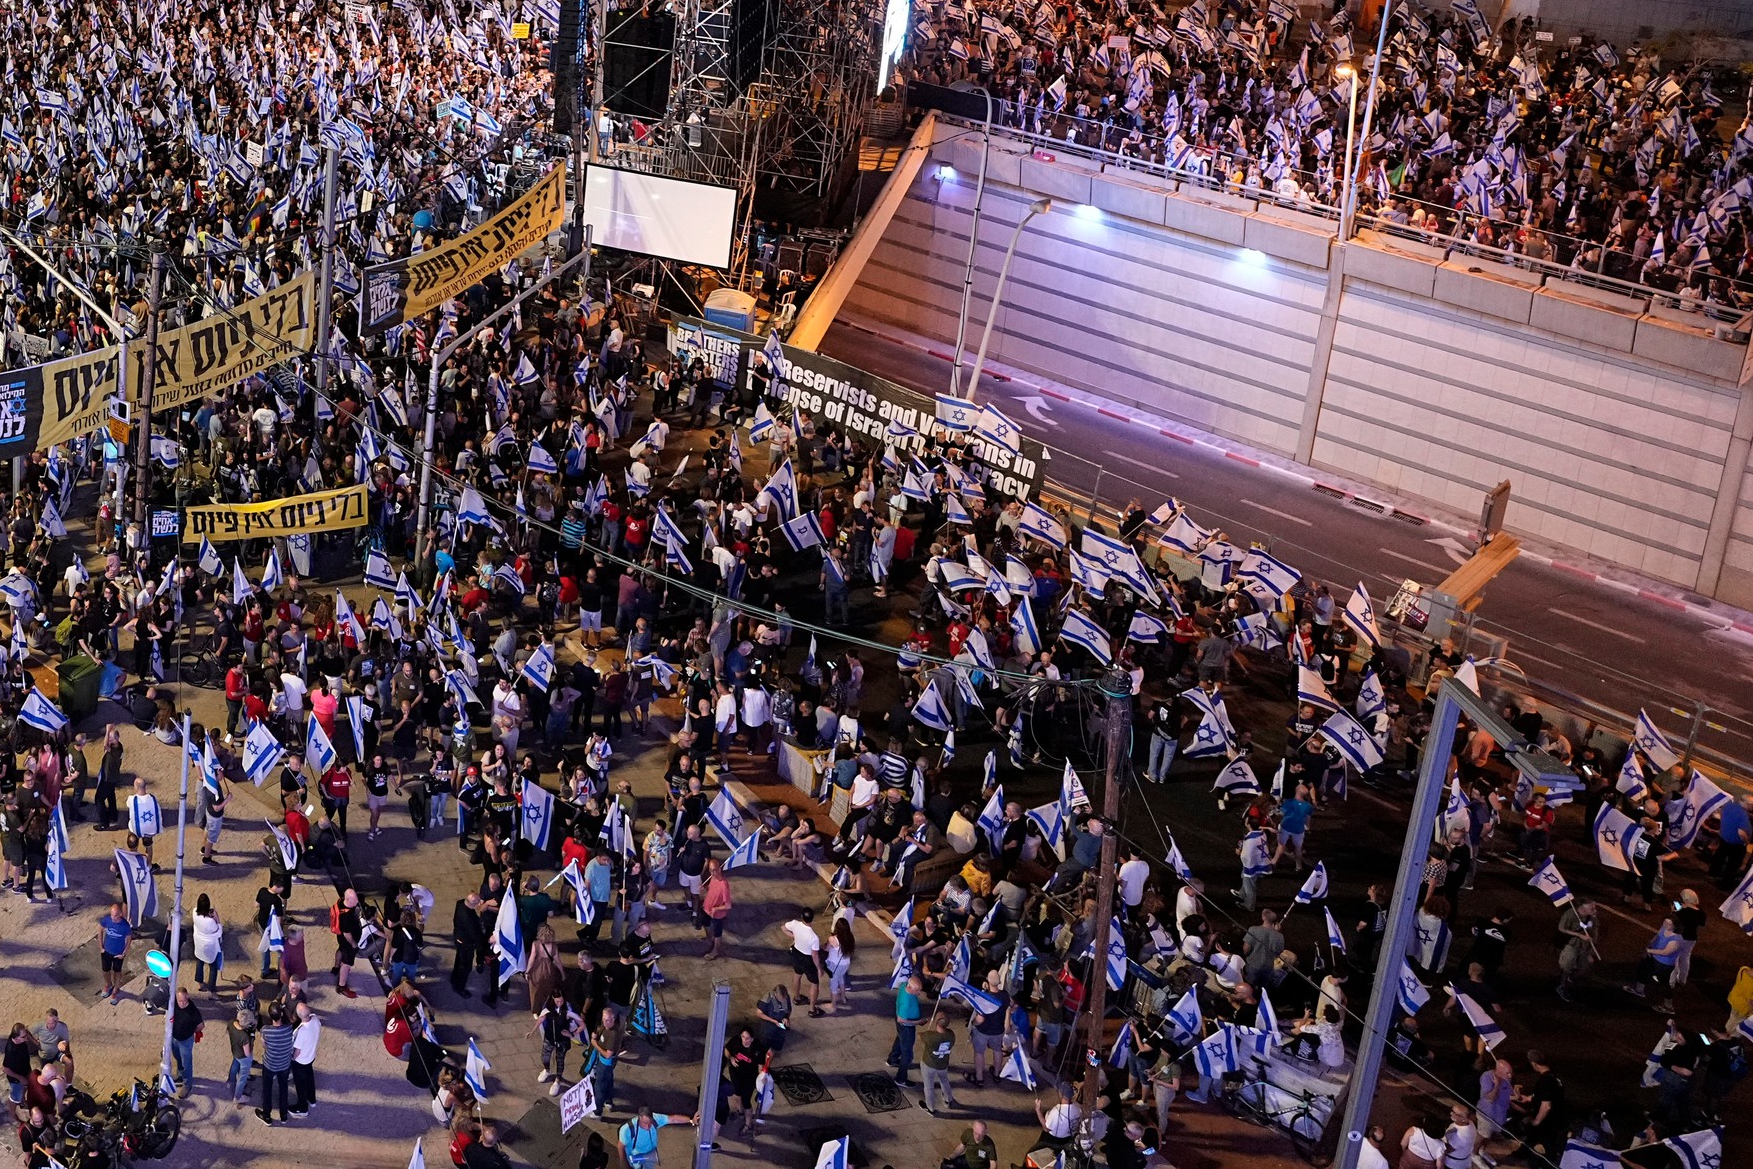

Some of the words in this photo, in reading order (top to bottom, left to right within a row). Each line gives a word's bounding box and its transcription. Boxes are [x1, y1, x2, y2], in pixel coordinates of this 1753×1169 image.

[260, 285, 309, 338] בלי
[677, 327, 741, 358] BRTHERS
[133, 338, 182, 399] אן
[781, 358, 877, 412] Reservists
[878, 399, 918, 430] and
[1013, 452, 1036, 480] in
[824, 397, 845, 424] of
[245, 508, 276, 533] אין
[280, 499, 327, 529] גיוס
[330, 491, 365, 521] בלי
[192, 511, 239, 534] פיוס
[563, 1088, 579, 1108] NOT
